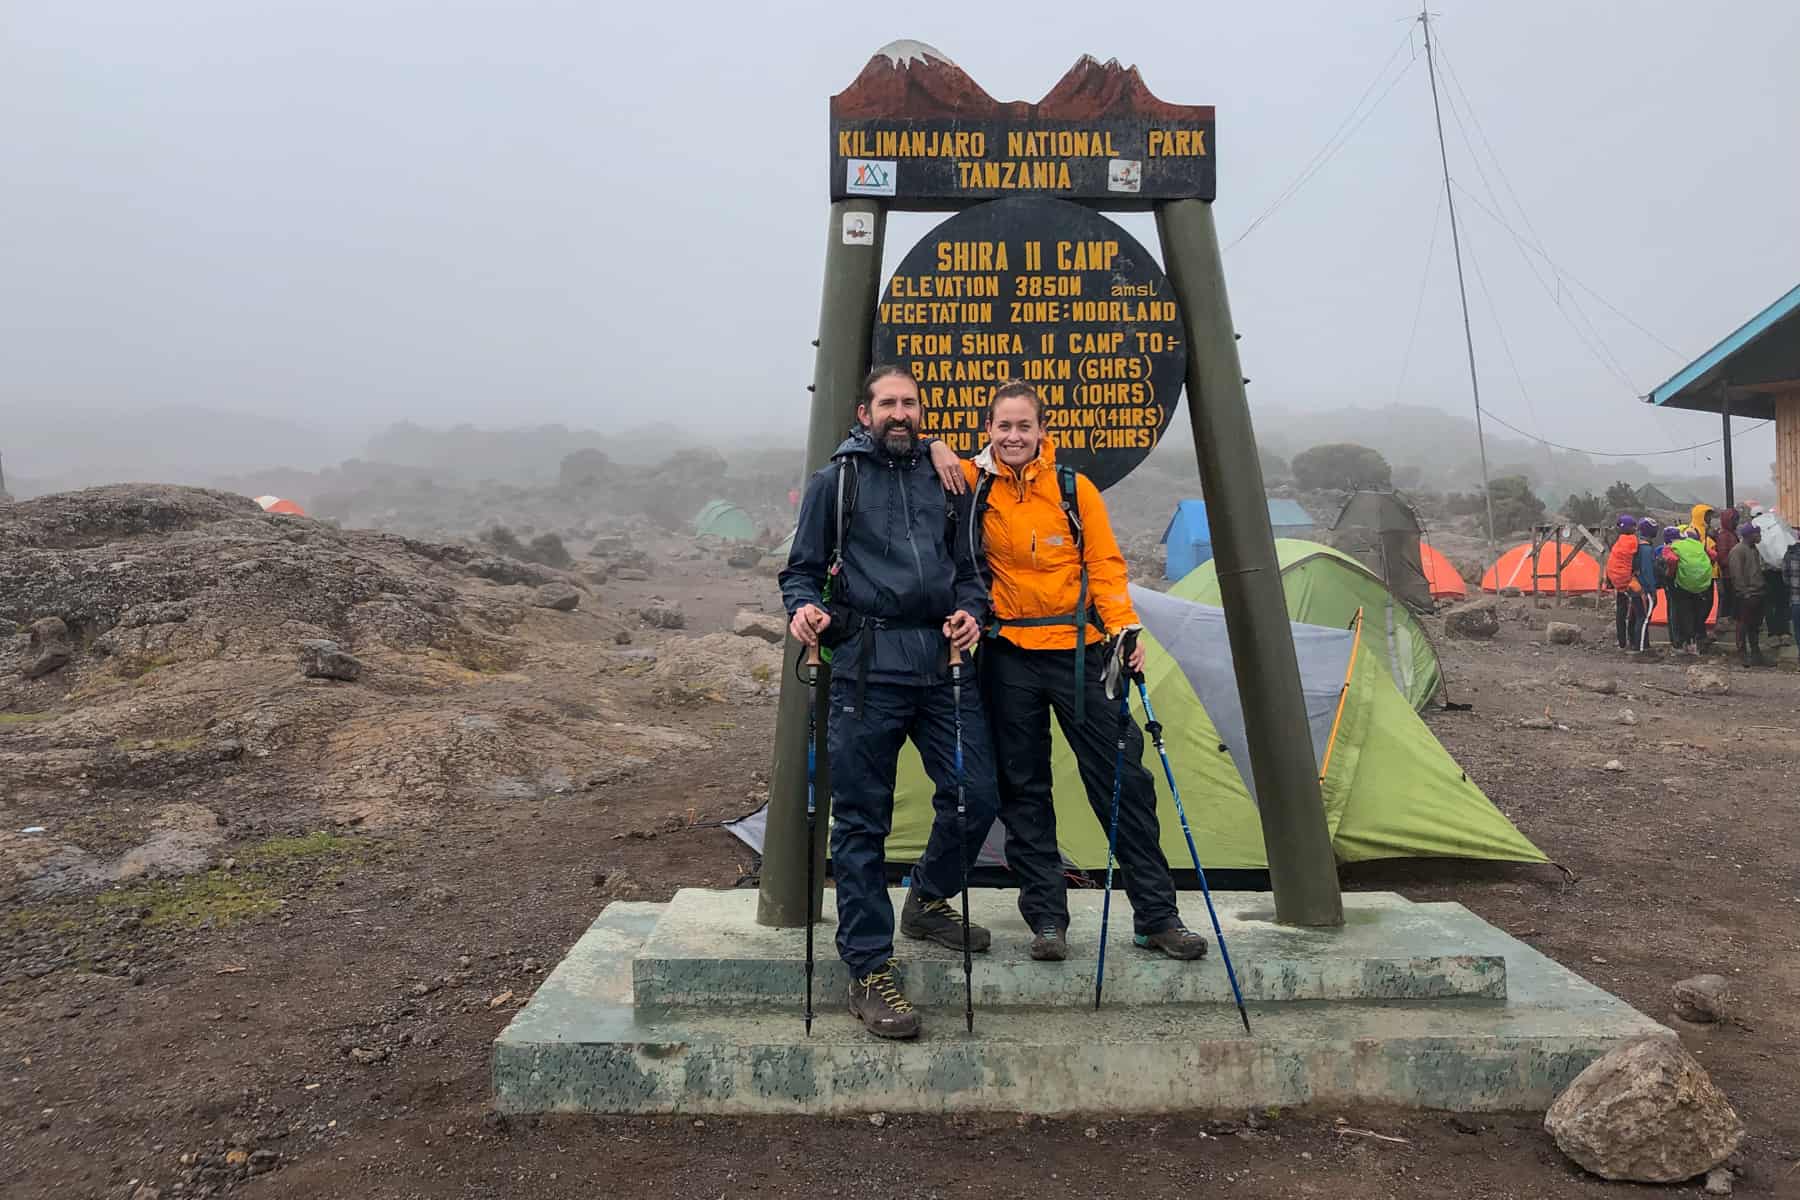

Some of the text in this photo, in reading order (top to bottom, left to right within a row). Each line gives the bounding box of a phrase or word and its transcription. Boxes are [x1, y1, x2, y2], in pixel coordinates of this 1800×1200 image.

[840, 131, 1204, 157] KILIMANJARO NATIONAL PARK
[960, 162, 1070, 188] TANZANIA
[938, 242, 1008, 271] SHIRA
[1058, 241, 1118, 270] CAMP
[892, 276, 1158, 297] ELEVATION 3850M amsl
[881, 303, 991, 323] VEGETATION
[897, 335, 951, 355] FROM
[962, 334, 1023, 354] SHIRA
[1070, 333, 1124, 353] CAMP
[911, 355, 1152, 383] BARANCO 10KM (6HRS)
[1073, 380, 1154, 407] (10HRS)
[1089, 427, 1158, 455] (21HRS)
